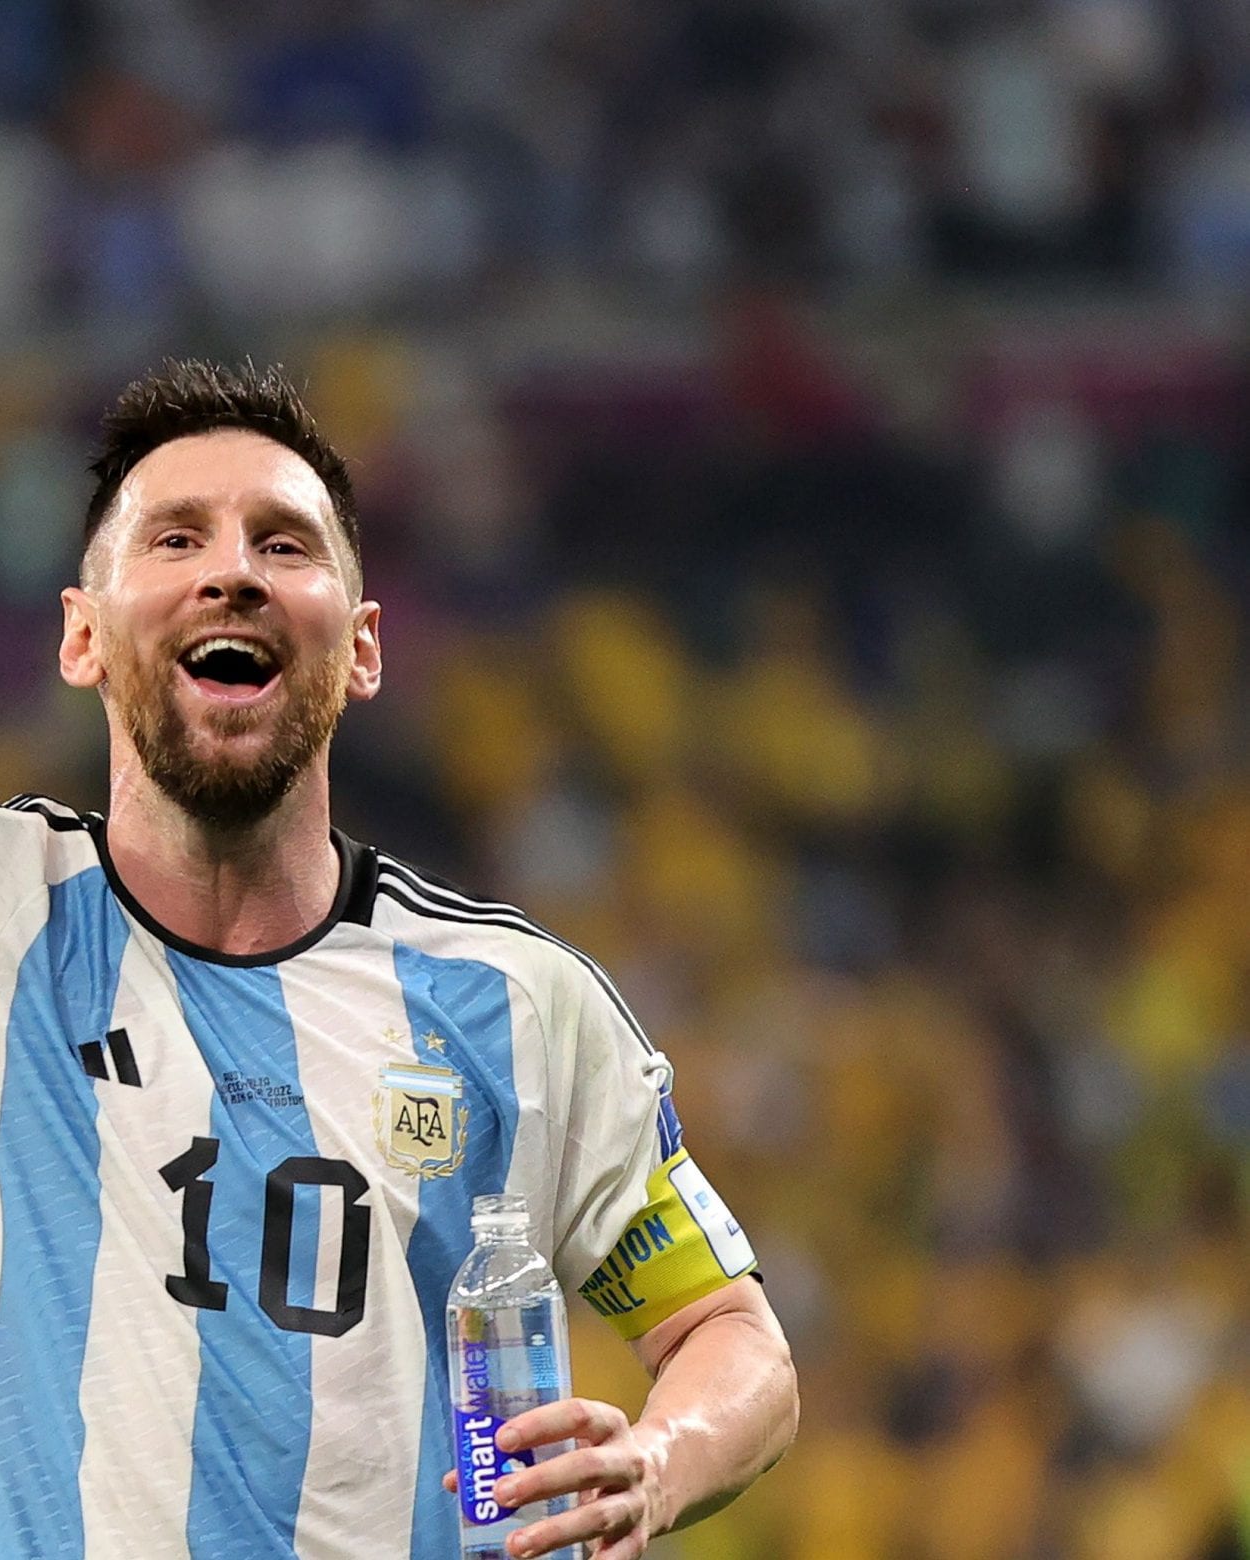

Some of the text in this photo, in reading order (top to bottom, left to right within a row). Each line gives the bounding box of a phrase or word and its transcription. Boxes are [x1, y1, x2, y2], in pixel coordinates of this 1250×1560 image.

[266, 1085, 292, 1097] 2022
[395, 1092, 446, 1147] AFA
[158, 1136, 371, 1338] 10
